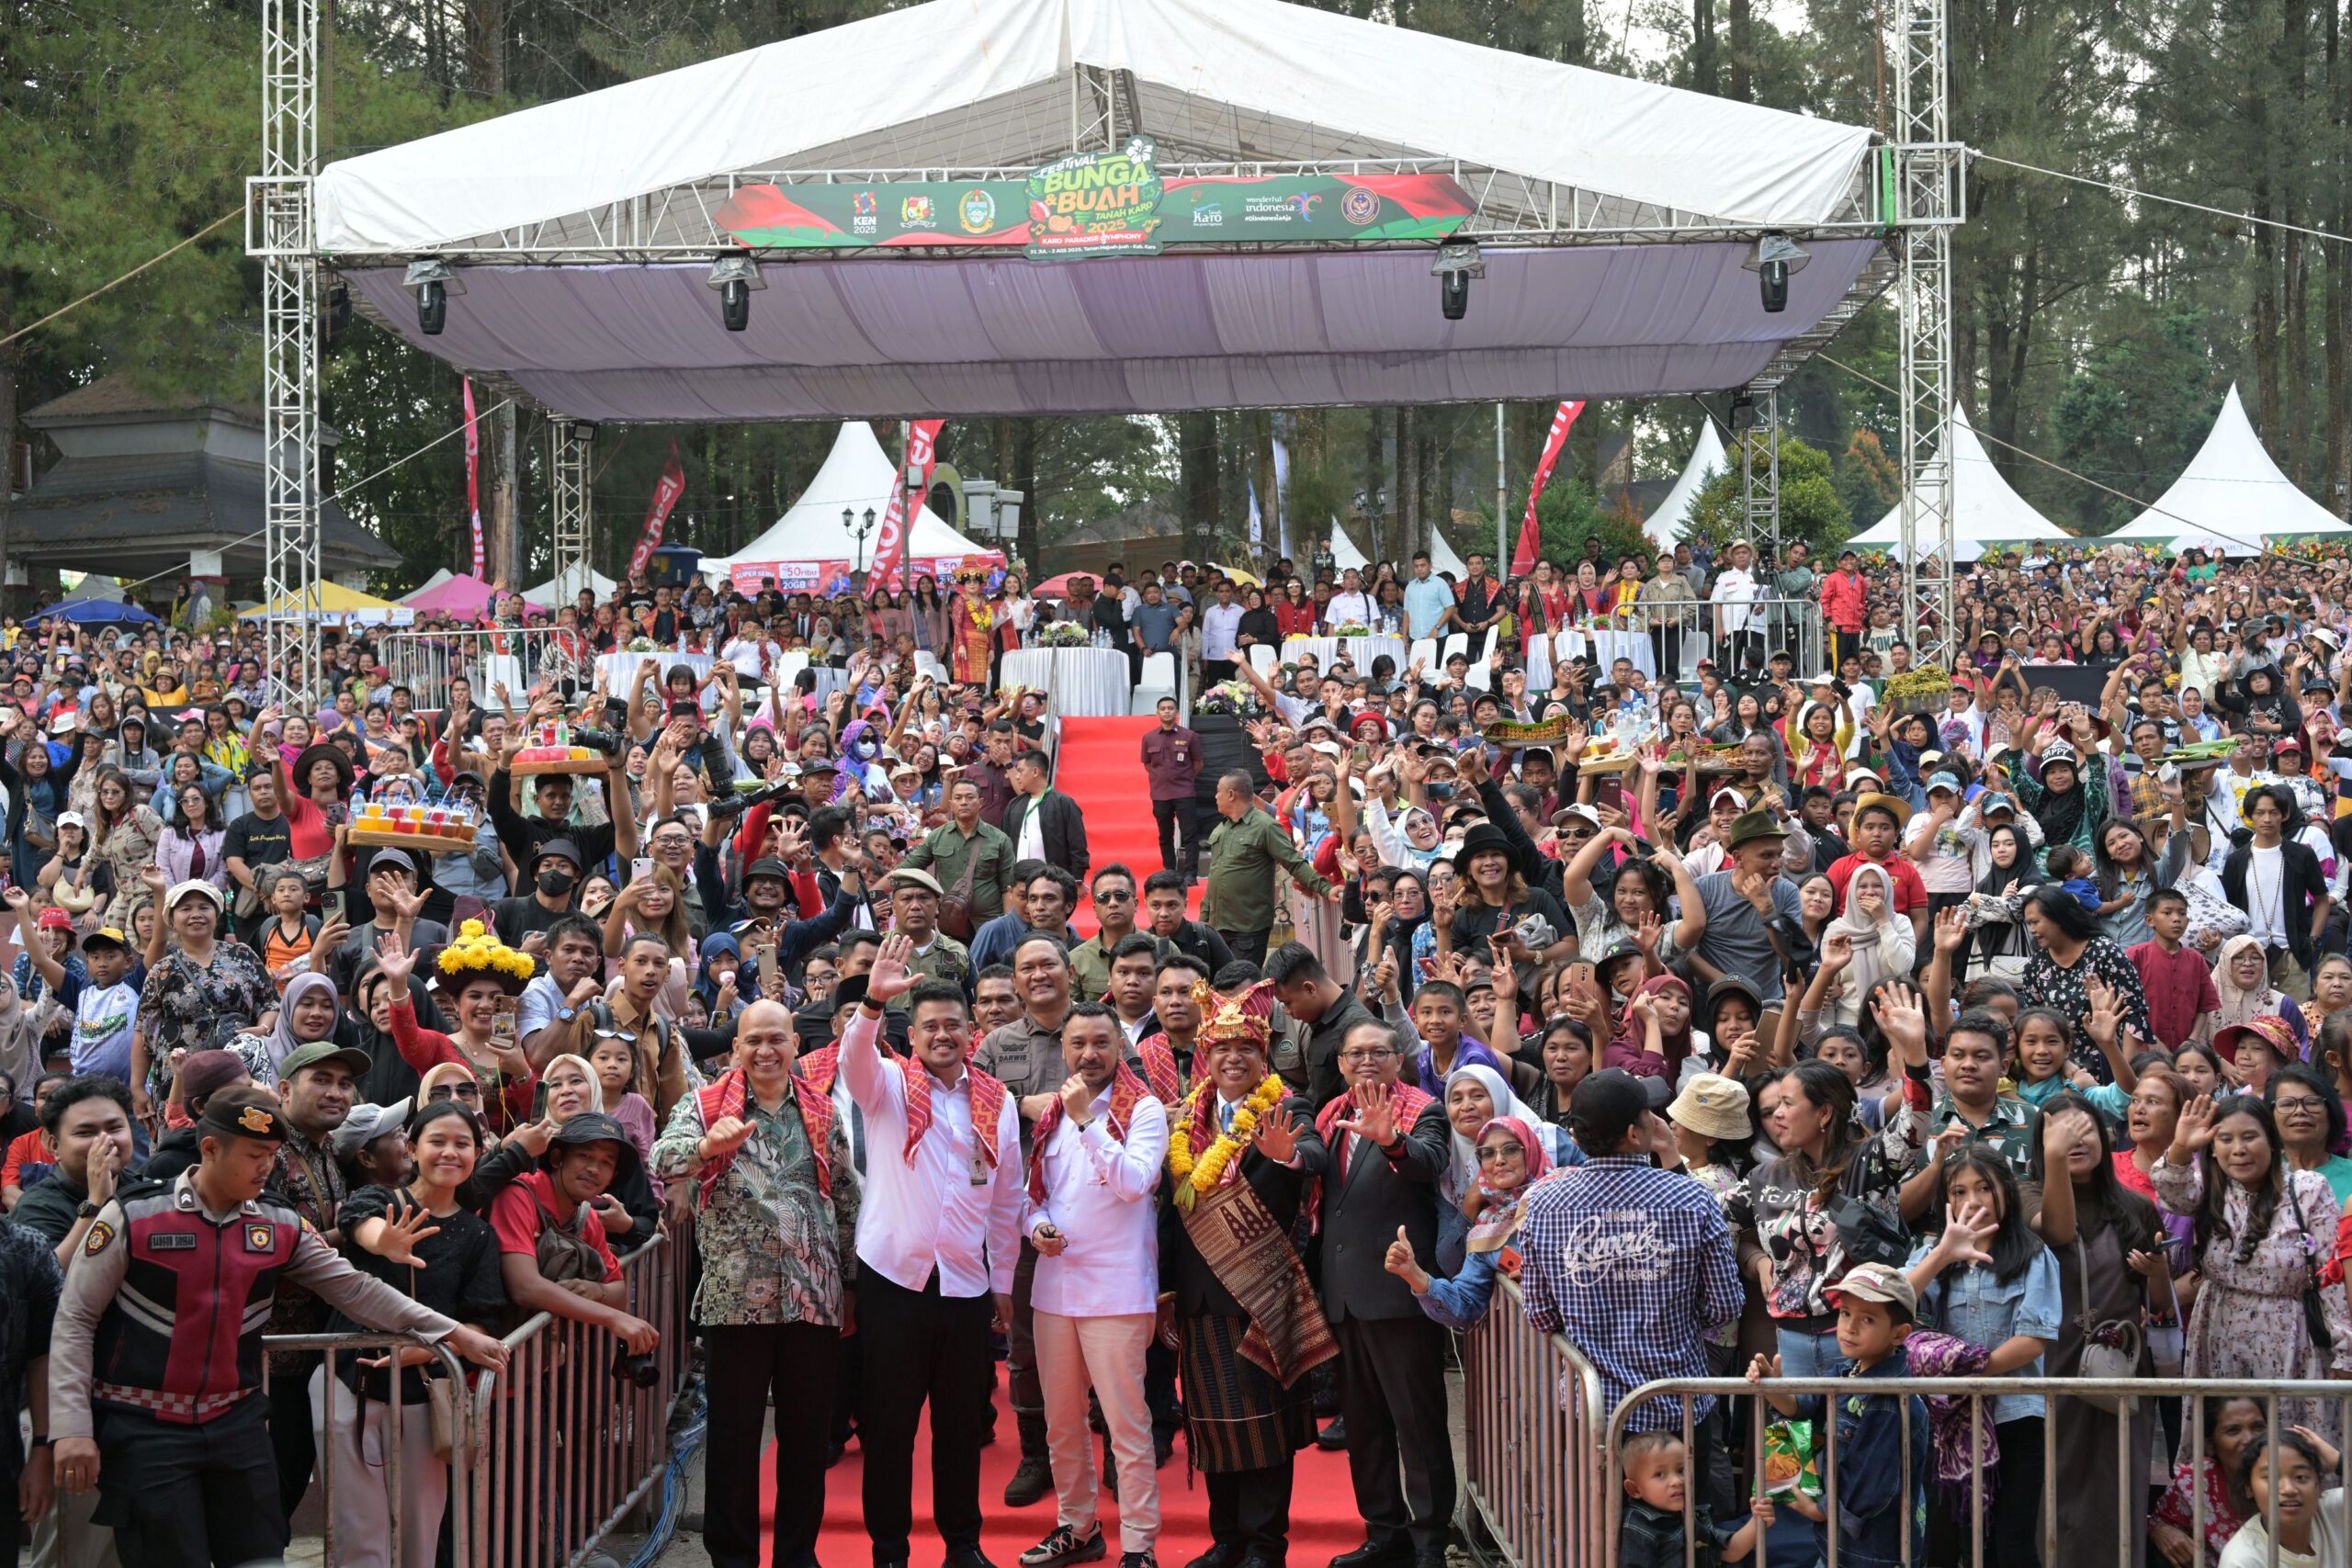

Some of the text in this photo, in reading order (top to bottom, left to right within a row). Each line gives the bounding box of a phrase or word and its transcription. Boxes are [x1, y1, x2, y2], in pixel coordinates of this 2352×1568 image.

[1040, 154, 1097, 176] FESTIVAL
[1044, 161, 1150, 193] BUNGA
[1045, 183, 1139, 214] & BUAH
[1095, 201, 1153, 220] TANAH KARO
[1245, 203, 1295, 212] indonesia
[854, 216, 876, 226] KEN
[1193, 210, 1222, 223] Karo
[854, 226, 876, 234] 2025
[1087, 219, 1128, 233] 2025
[1064, 235, 1100, 243] PARADISE
[782, 581, 807, 590] 20GB
